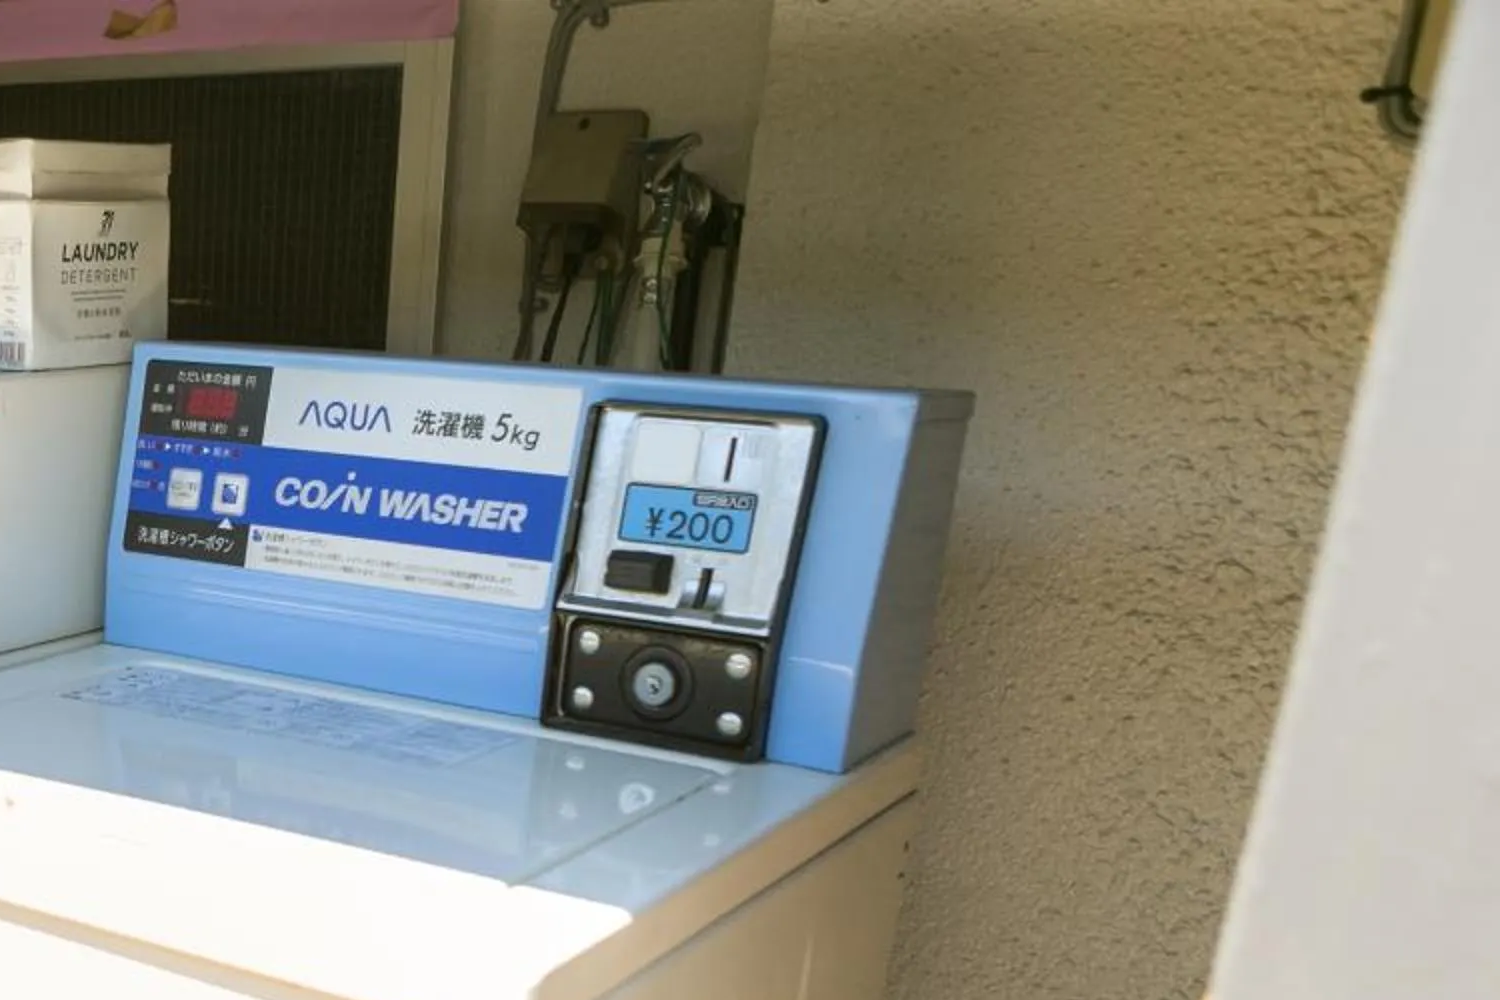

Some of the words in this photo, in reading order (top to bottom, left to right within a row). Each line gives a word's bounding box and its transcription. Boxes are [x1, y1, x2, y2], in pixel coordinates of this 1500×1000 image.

[61, 241, 139, 263] LAUNDRY
[60, 267, 138, 285] DETERGENT
[299, 400, 391, 433] AQUA
[412, 409, 486, 440] 洗濯機
[491, 413, 540, 451] 5kg
[379, 488, 528, 533] WASHER
[645, 507, 734, 544] ¥200
